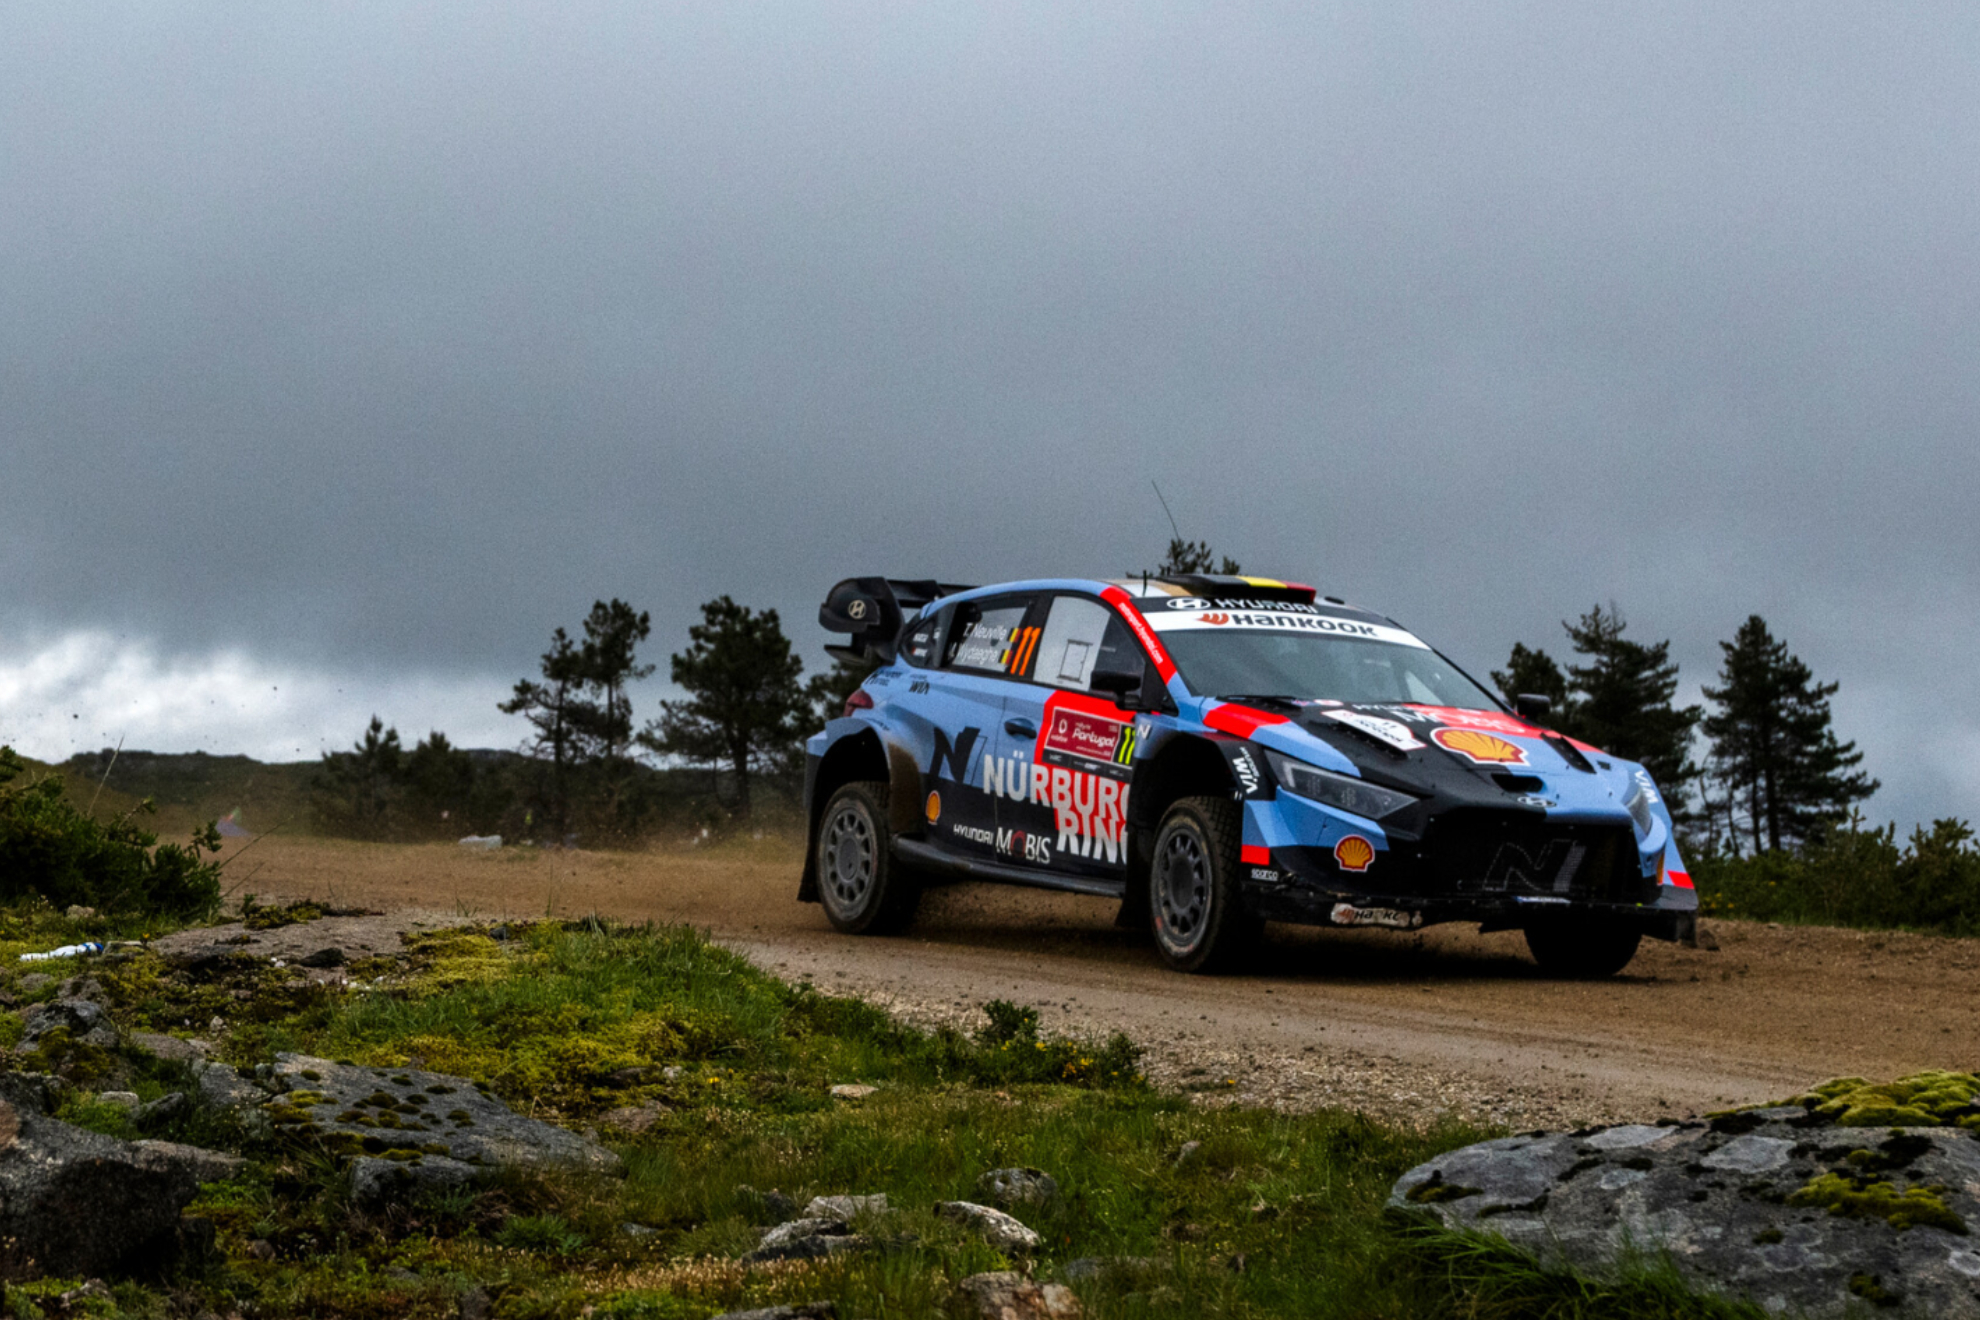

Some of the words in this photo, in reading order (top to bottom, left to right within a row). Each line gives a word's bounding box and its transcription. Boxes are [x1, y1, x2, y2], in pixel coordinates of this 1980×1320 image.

[1214, 598, 1318, 614] HYUNDAI
[1010, 626, 1041, 676] 11
[1072, 728, 1116, 748] Portugal
[953, 823, 994, 845] HYUNDAI
[995, 826, 1051, 865] MOBIS
